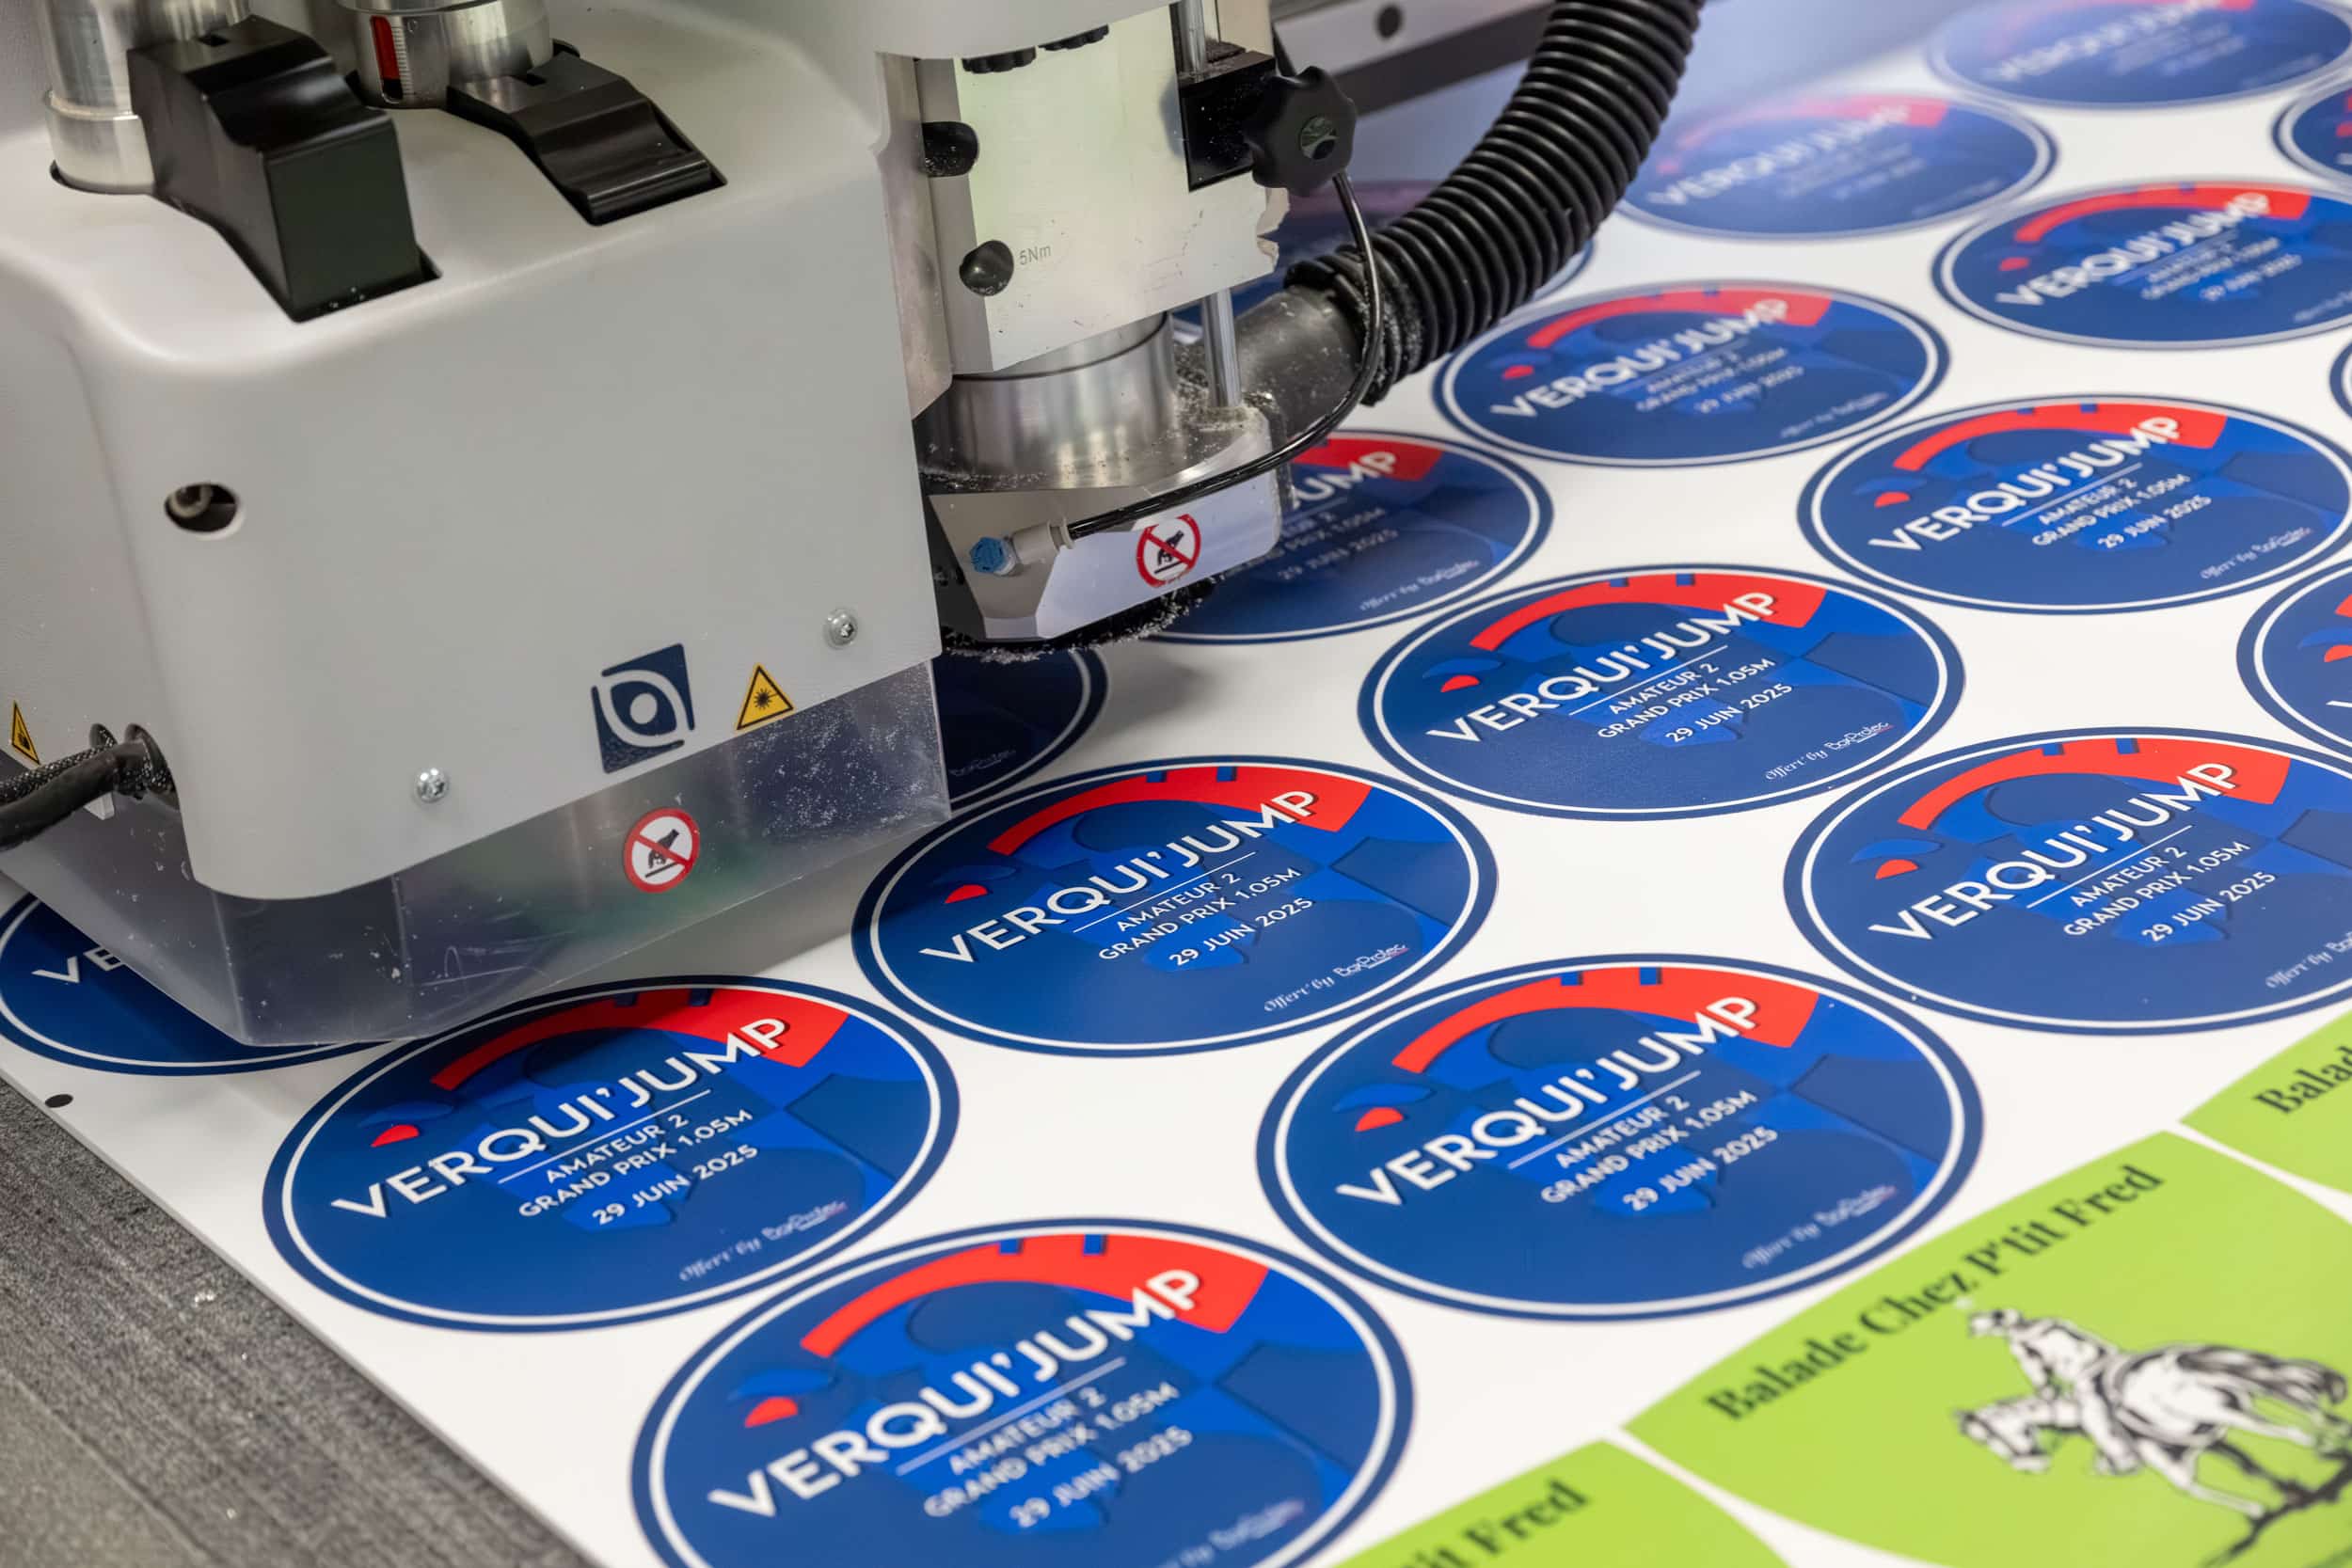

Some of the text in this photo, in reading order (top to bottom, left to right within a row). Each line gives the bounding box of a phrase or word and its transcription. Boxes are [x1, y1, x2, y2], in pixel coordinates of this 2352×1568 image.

[1019, 245, 1051, 266] 5Nm
[1866, 418, 2181, 549] VERQUI'JUMP
[1425, 593, 1774, 742] VERQUI'JUMP
[1609, 663, 1720, 715] AMATEUR 2
[1597, 705, 1669, 737] GRAND
[1666, 684, 1720, 707] PRIX
[1665, 684, 1792, 743] 29 JUIN 2025
[918, 791, 1314, 963] VERQUI'JUMP
[1867, 763, 2238, 940] VERQUI'JUMP
[2071, 847, 2188, 908] AMATEUR 2
[1098, 922, 1179, 959] GRAND
[1178, 896, 1237, 925] PRIX
[1117, 873, 1242, 932] AMATEUR 2
[1168, 897, 1312, 966] 29 JUIN 2025
[2063, 897, 2139, 935] GRAND
[2135, 871, 2193, 899] PRIX
[2141, 871, 2276, 942] 29 JUIN 2025
[329, 1019, 786, 1218] VERQUI'JUMP
[1335, 997, 1756, 1204] VERQUI'JUMP
[1556, 1097, 1691, 1168] AMATEUR 2
[518, 1172, 611, 1215] GRAND
[612, 1143, 677, 1175] PRIX
[547, 1115, 690, 1183] AMATEUR 2
[592, 1145, 757, 1225] 29 JUIN 2025
[1542, 1156, 1629, 1201] GRAND
[1626, 1125, 1690, 1159] PRIX
[1623, 1127, 1777, 1211] 29 JUIN 2025
[1704, 1332, 1869, 1420] Balade
[1858, 1271, 1979, 1334] Chez
[2049, 1163, 2164, 1227] Fred
[707, 1271, 1198, 1515] VERQUI'JUMP
[926, 1461, 1025, 1514] GRAND
[1025, 1424, 1098, 1465] PRIX
[951, 1389, 1106, 1474] AMATEUR 2
[1463, 1478, 1588, 1555] Fred
